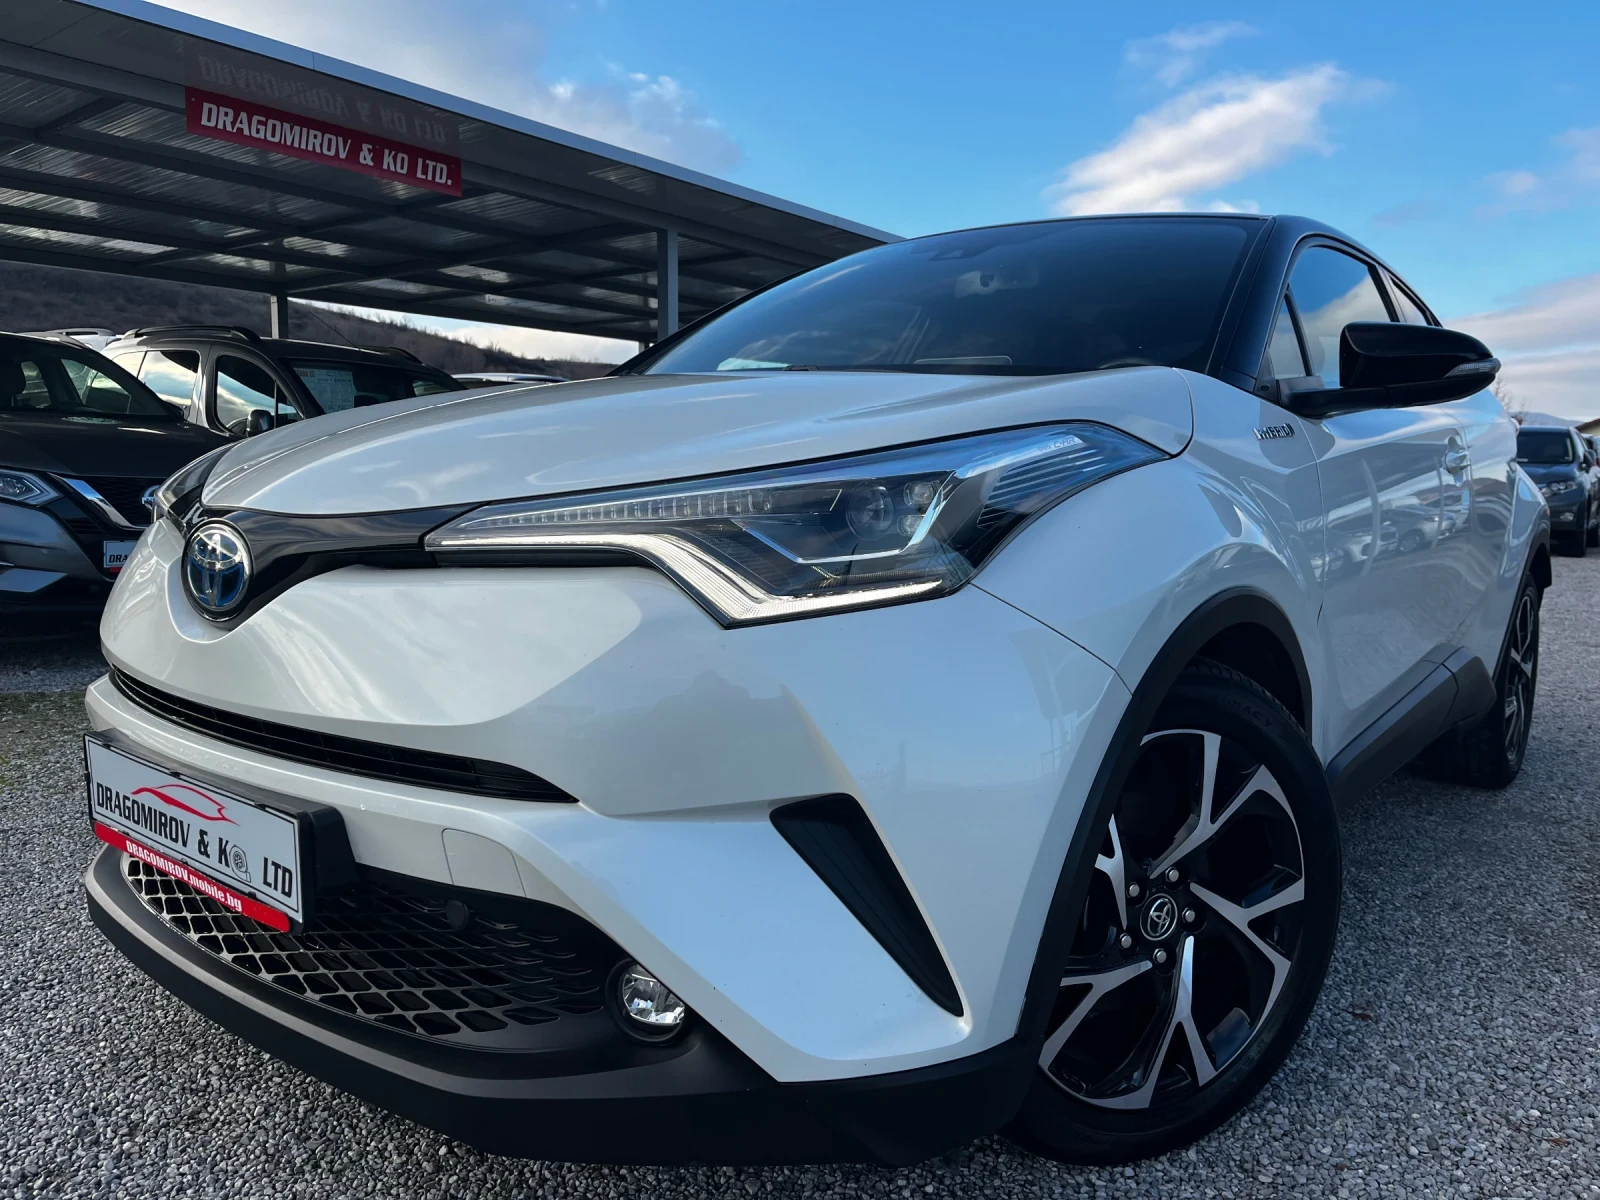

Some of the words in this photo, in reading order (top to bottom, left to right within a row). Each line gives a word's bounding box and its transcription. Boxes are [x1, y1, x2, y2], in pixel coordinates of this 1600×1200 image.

[201, 102, 351, 159] DRAGOMIROV
[359, 143, 374, 166] &
[382, 149, 408, 175] KO
[416, 157, 452, 185] LTD.
[96, 782, 190, 848] DRAGOMIROV
[198, 829, 211, 858] &
[262, 857, 293, 899] LTD
[125, 840, 242, 911] DRAGOMIROV.mobile.bg
